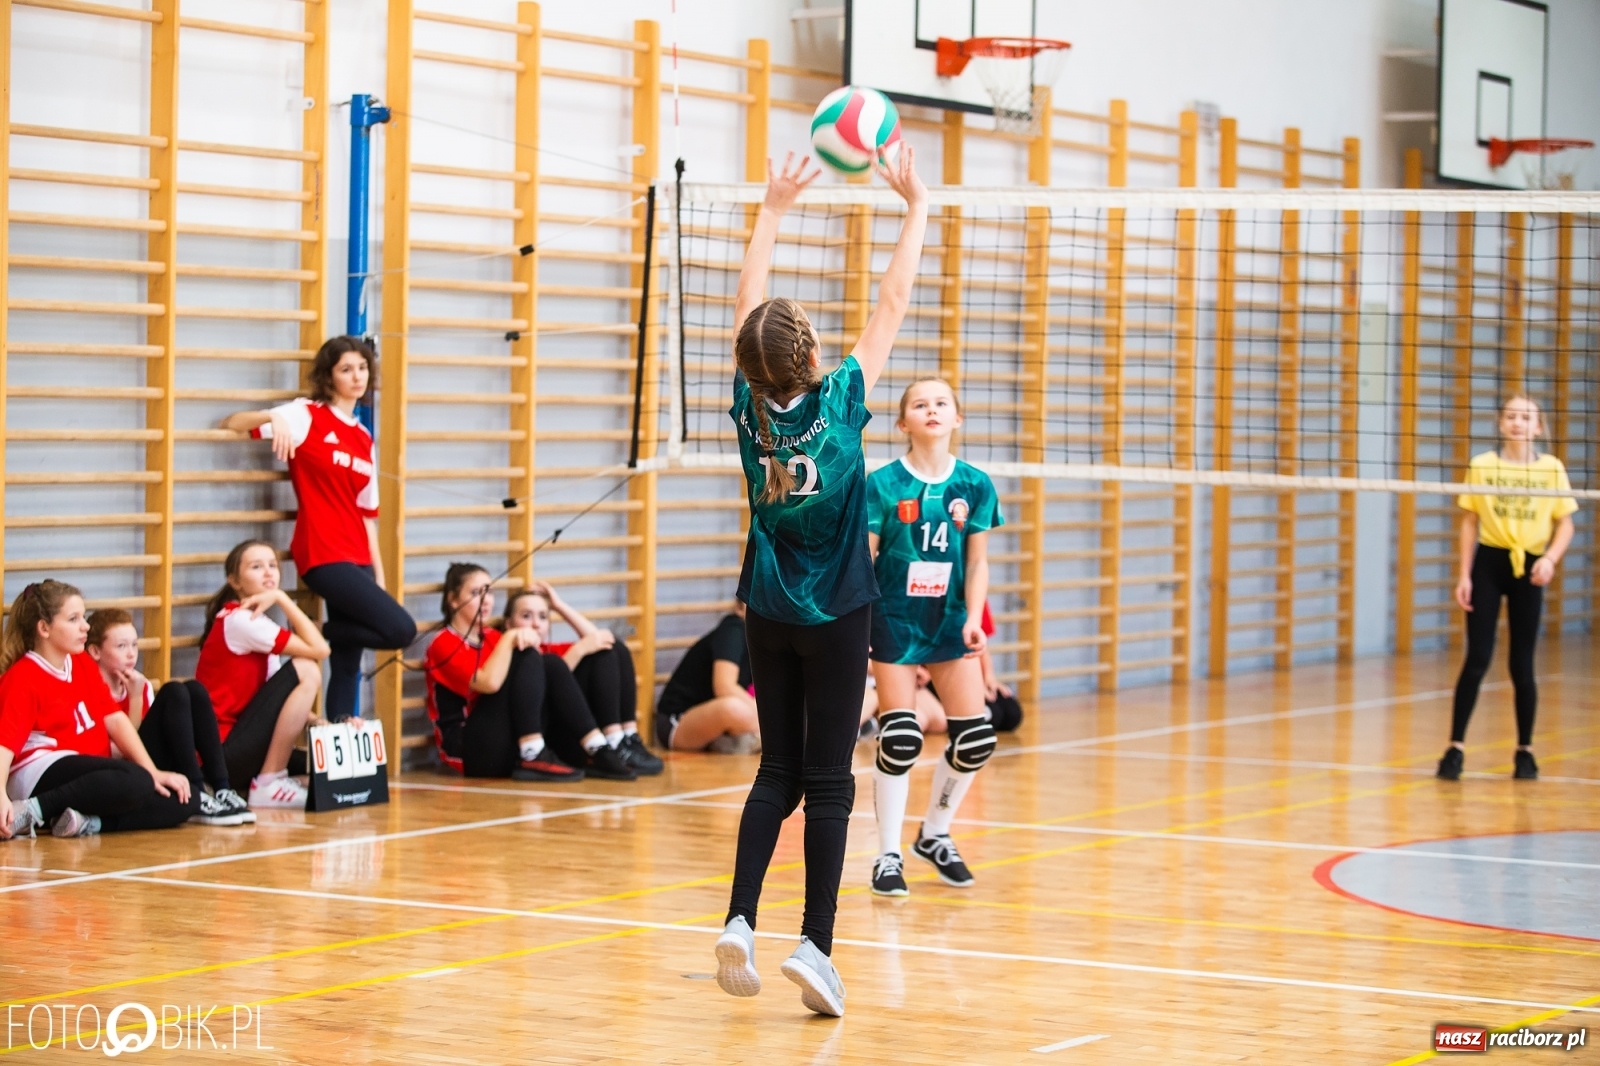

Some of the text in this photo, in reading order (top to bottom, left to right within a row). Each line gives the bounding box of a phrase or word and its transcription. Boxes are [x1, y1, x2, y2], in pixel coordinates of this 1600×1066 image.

[920, 521, 949, 552] 14
[315, 731, 383, 770] 0 5 10 0
